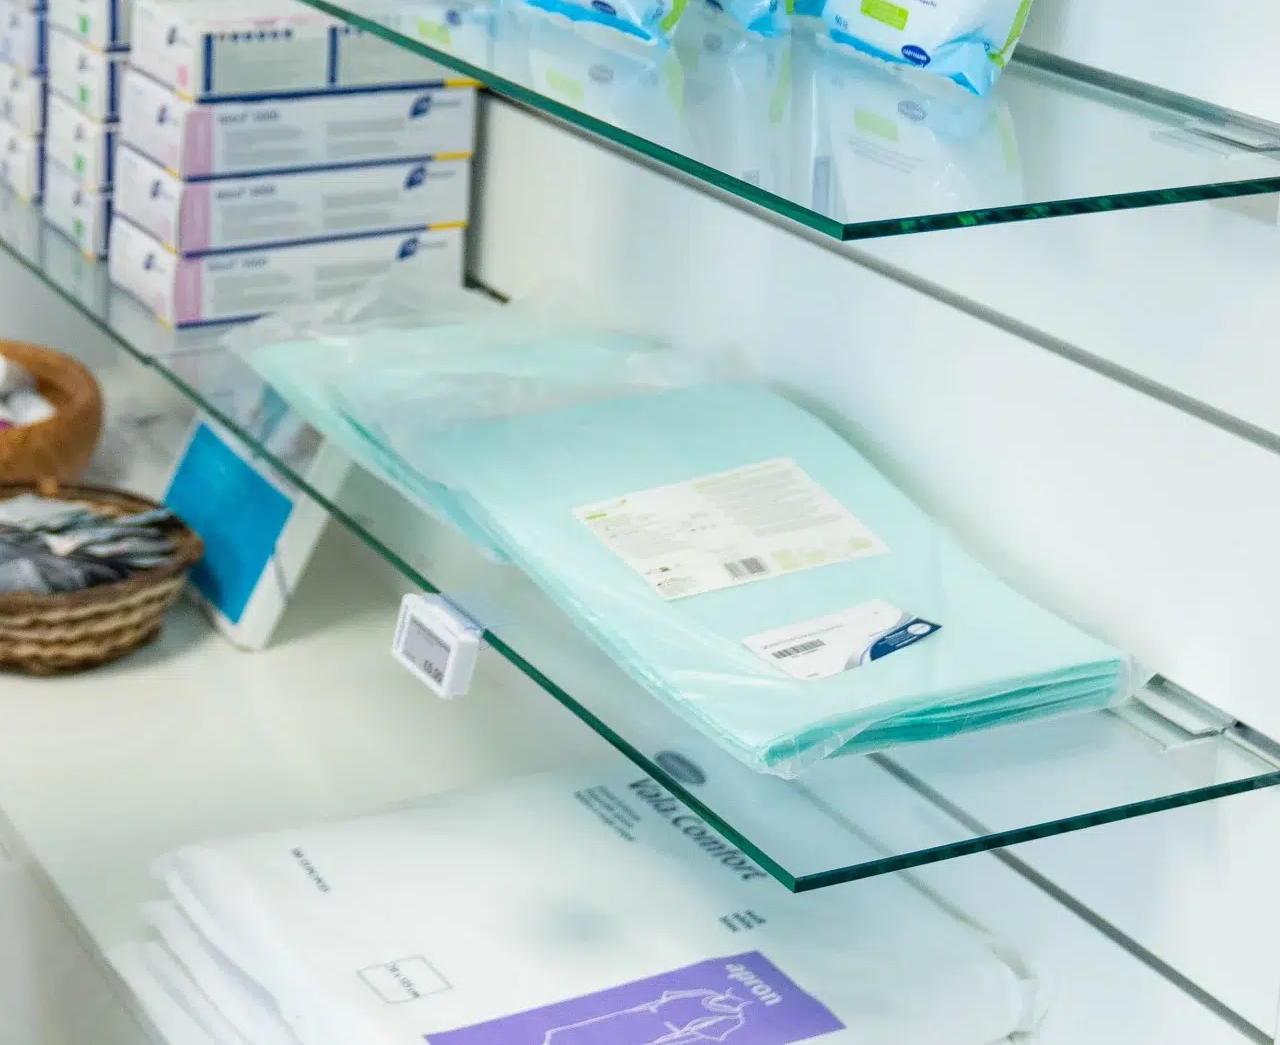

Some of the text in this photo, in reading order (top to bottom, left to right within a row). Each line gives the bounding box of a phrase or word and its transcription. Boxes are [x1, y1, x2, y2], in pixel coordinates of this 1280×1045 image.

[628, 777, 678, 818] Vala
[671, 815, 769, 881] Comfort
[725, 962, 782, 1007] apron
